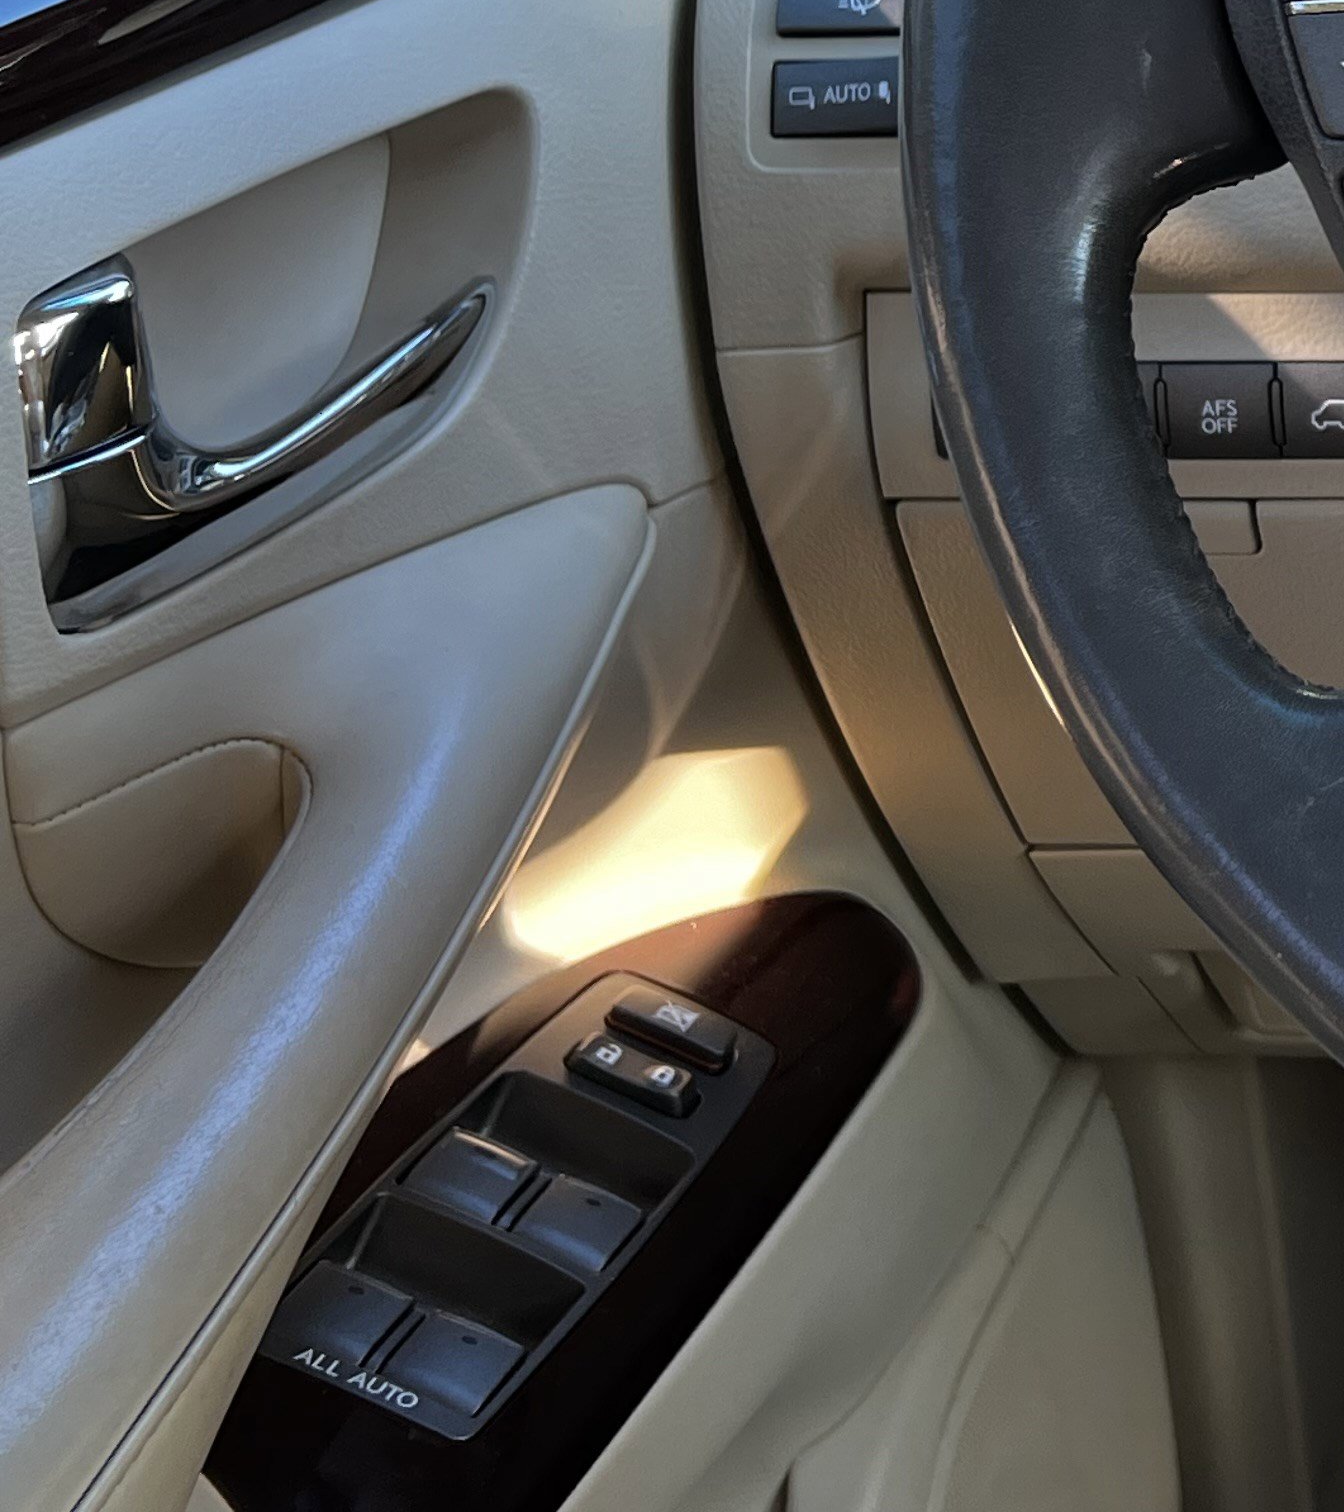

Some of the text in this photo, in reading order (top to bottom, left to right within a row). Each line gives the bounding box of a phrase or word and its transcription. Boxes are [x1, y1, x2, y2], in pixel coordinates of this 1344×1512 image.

[823, 82, 871, 105] AUTO
[1202, 399, 1238, 416] AFS
[1201, 417, 1238, 435] OFF
[293, 1348, 419, 1408] ALL AUTO
